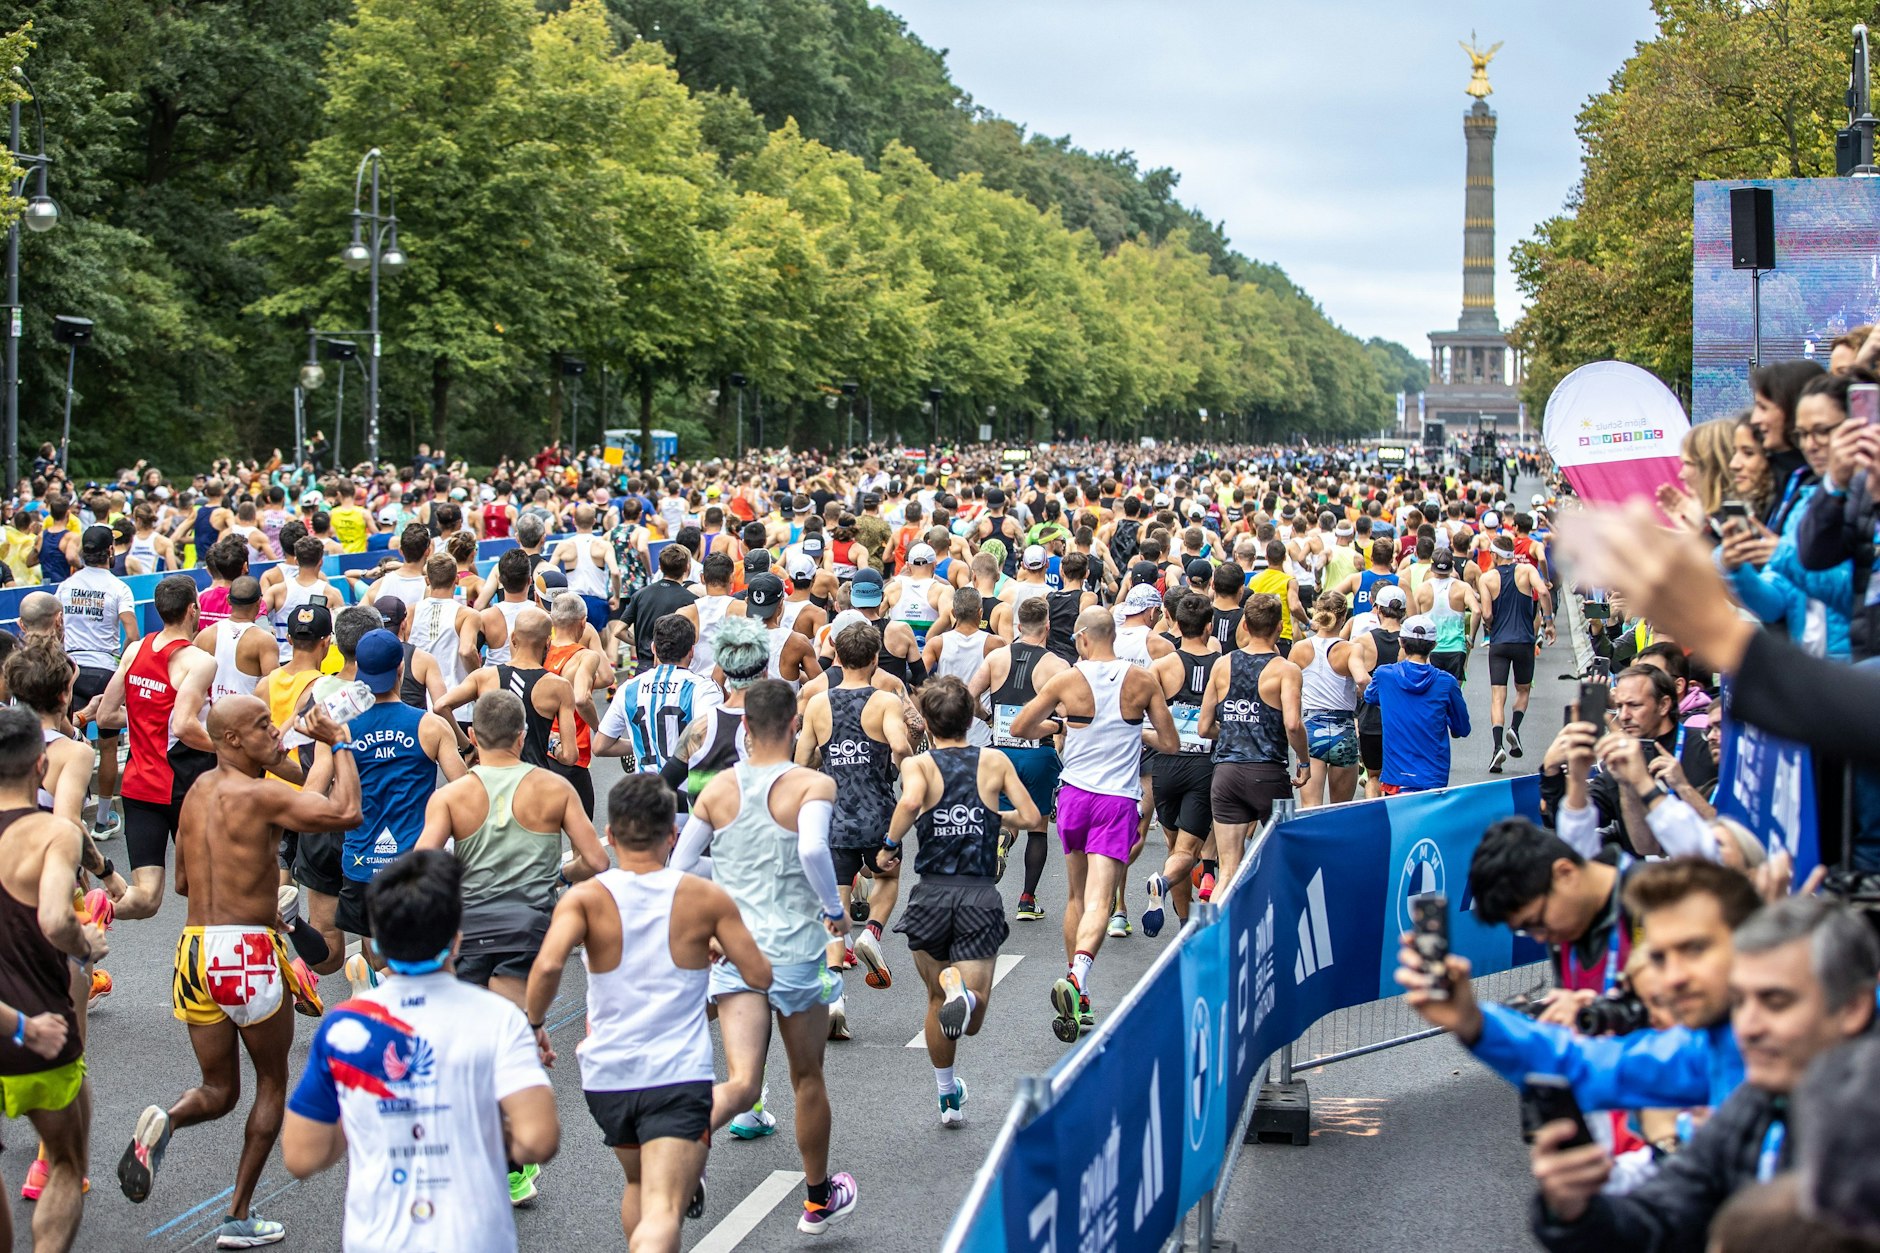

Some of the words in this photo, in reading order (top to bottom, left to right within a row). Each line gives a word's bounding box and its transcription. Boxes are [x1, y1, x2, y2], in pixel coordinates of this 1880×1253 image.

[71, 588, 106, 600] TEAMWORK
[71, 597, 91, 606] MAKES
[93, 599, 104, 608] THE
[65, 605, 84, 615] DREAM
[85, 607, 104, 617] WORK
[128, 674, 167, 694] KNOCKMANY
[641, 682, 679, 694] MESSI
[1223, 699, 1260, 715] SCC
[1223, 713, 1260, 723] BERLIN
[632, 705, 688, 766] 10
[375, 746, 396, 759] AIK
[828, 739, 870, 758] SCC
[831, 755, 871, 767] BERLIN
[933, 804, 984, 826] SCC
[933, 825, 984, 837] BERLIN
